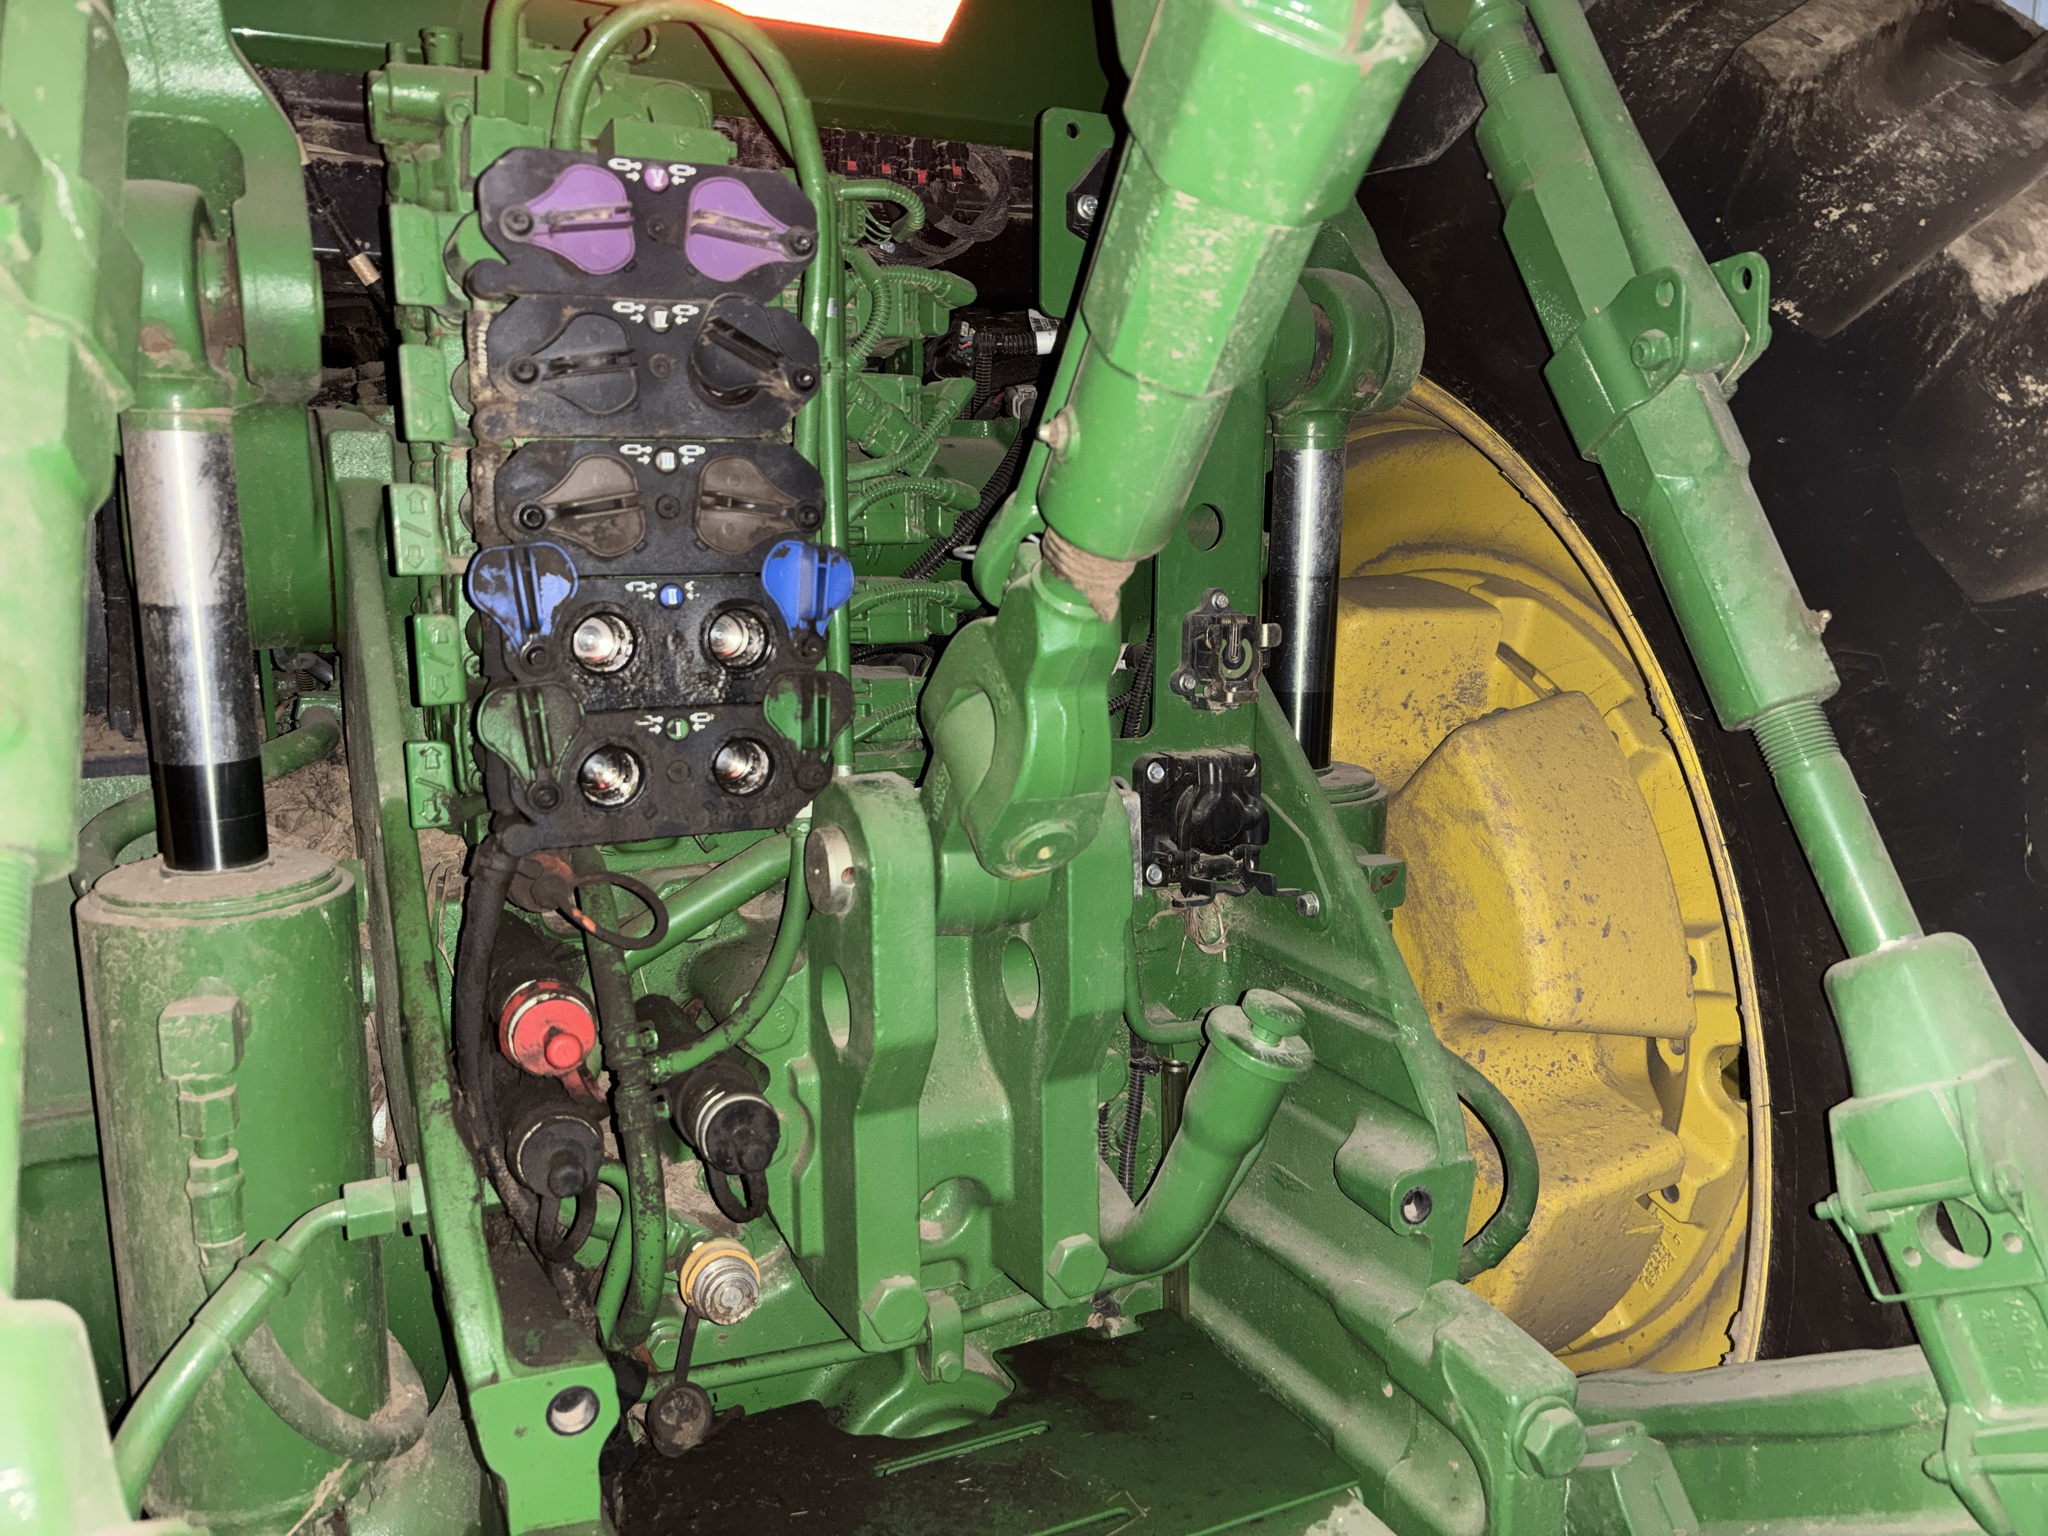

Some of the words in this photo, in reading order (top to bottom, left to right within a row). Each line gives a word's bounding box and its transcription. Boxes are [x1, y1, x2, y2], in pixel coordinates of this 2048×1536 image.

[650, 168, 665, 187] V
[660, 452, 675, 470] III
[667, 588, 678, 605] II
[675, 721, 682, 737] I
